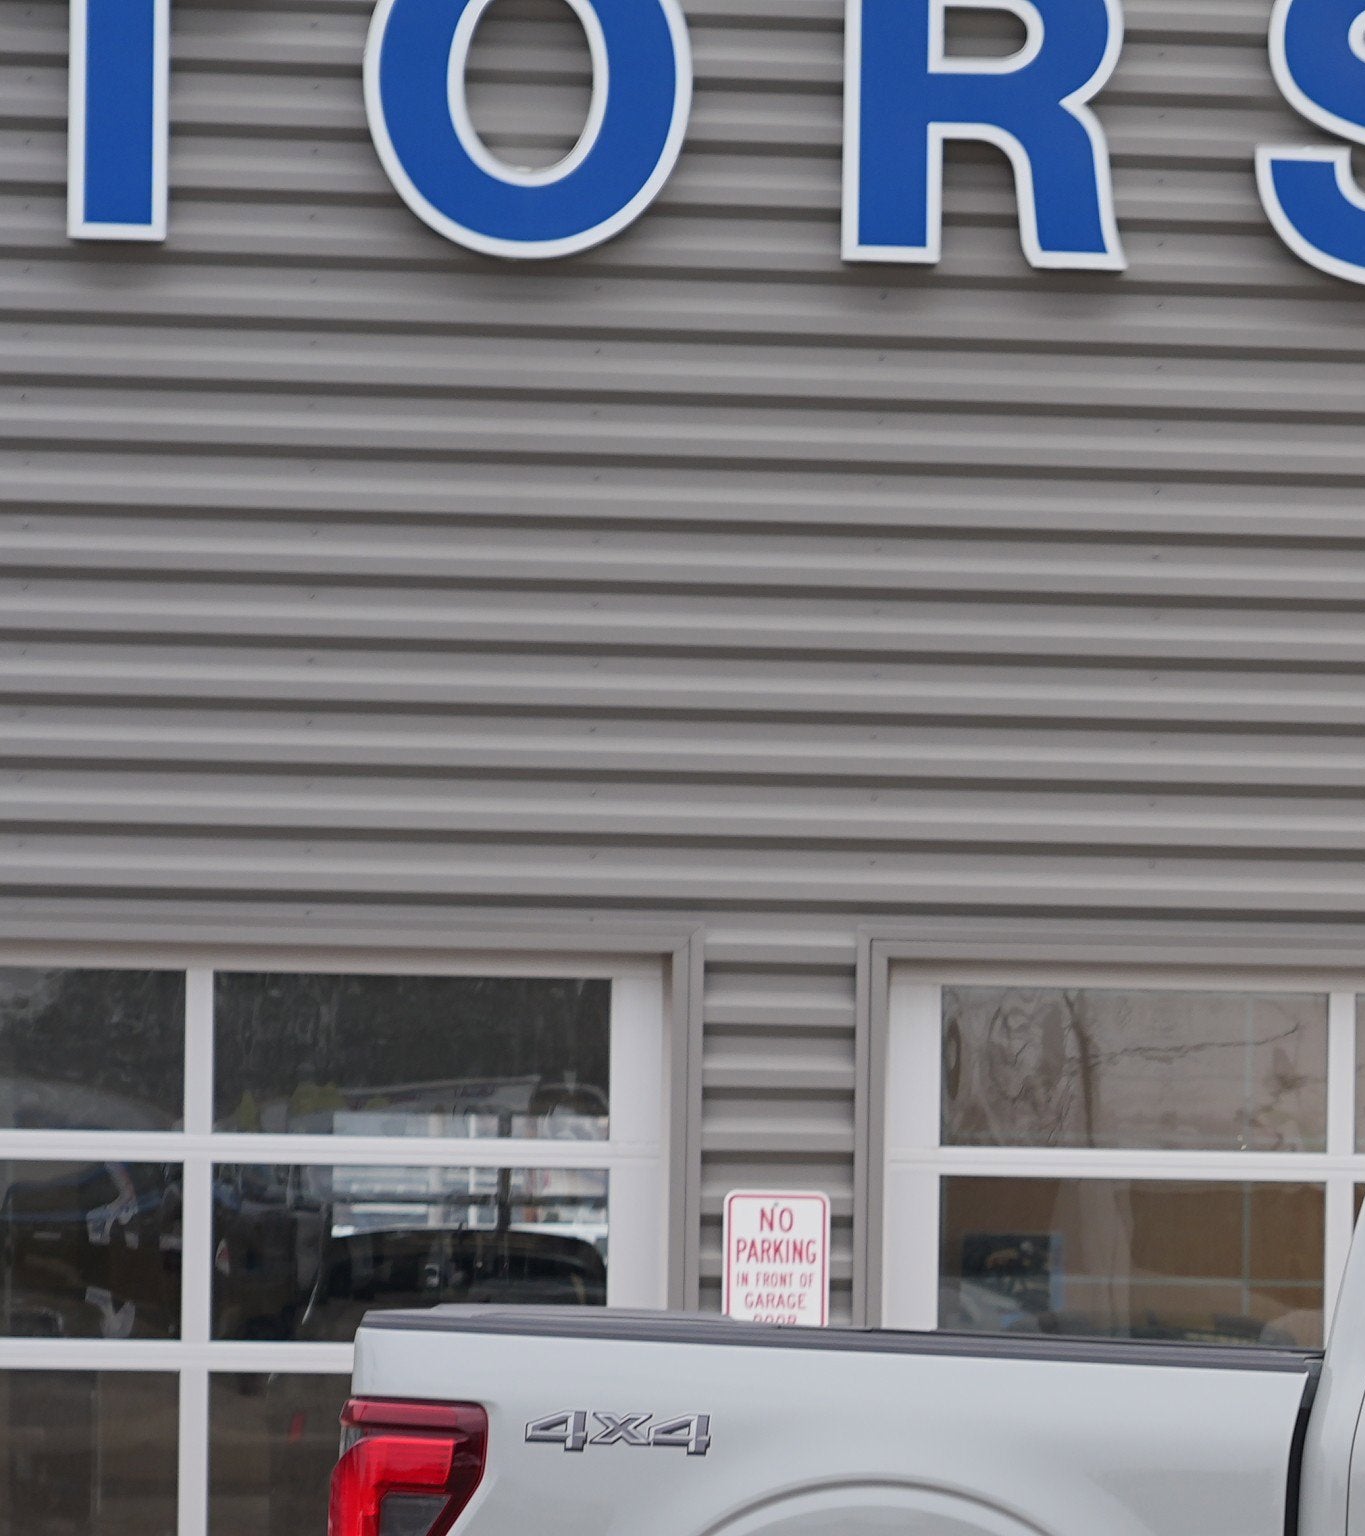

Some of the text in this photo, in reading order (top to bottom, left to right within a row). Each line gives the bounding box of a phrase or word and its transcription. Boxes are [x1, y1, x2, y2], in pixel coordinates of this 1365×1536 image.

[760, 1207, 794, 1232] NO
[736, 1238, 817, 1264] PARKING
[736, 1271, 815, 1289] IN FRONT OF
[744, 1292, 808, 1309] GARAGE
